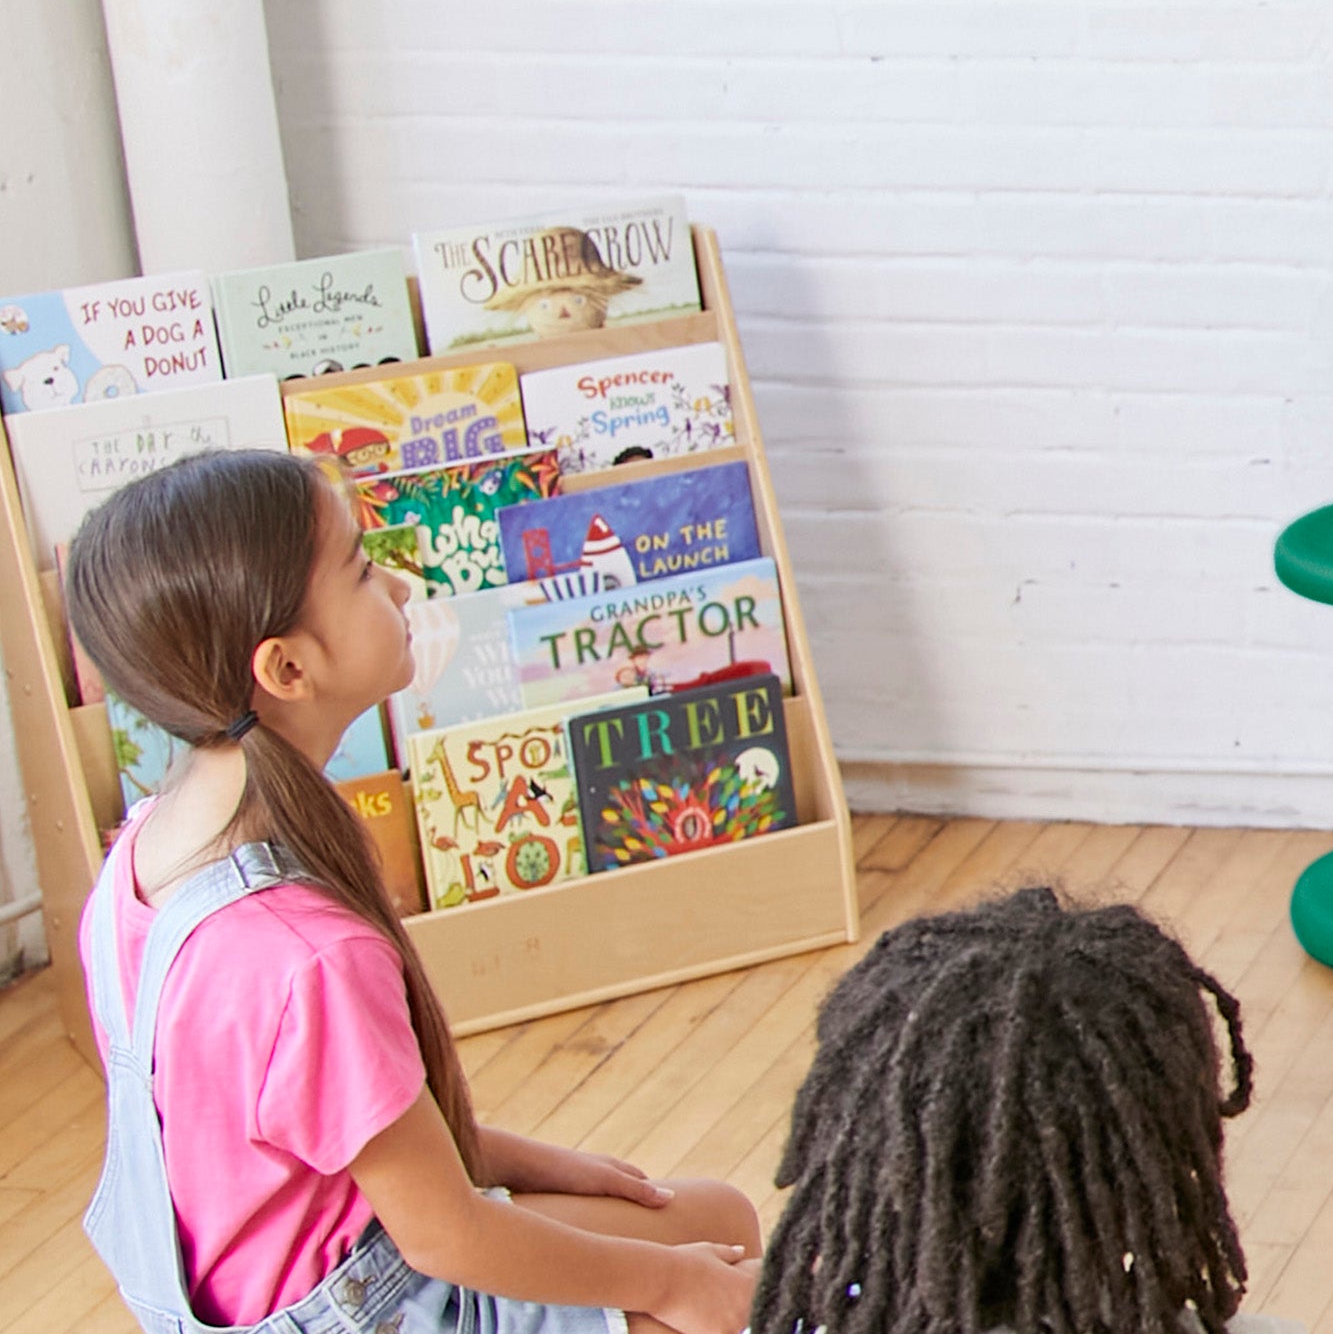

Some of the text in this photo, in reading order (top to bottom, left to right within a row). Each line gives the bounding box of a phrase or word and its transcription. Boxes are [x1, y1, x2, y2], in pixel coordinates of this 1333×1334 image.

[81, 290, 202, 325] IF YOU GIVE
[125, 319, 204, 350] A DOG A
[144, 347, 207, 377] DONUT
[577, 370, 674, 399] Spencer
[411, 403, 477, 435] Dream
[591, 405, 671, 437] Spring
[402, 417, 505, 469] BIG
[635, 518, 728, 553] ON THE
[639, 544, 730, 578] LAUNCH
[590, 585, 707, 622] GRANDPA'S
[540, 594, 761, 669] TRACTOR
[583, 687, 775, 769] TREE
[350, 789, 392, 819] ks
